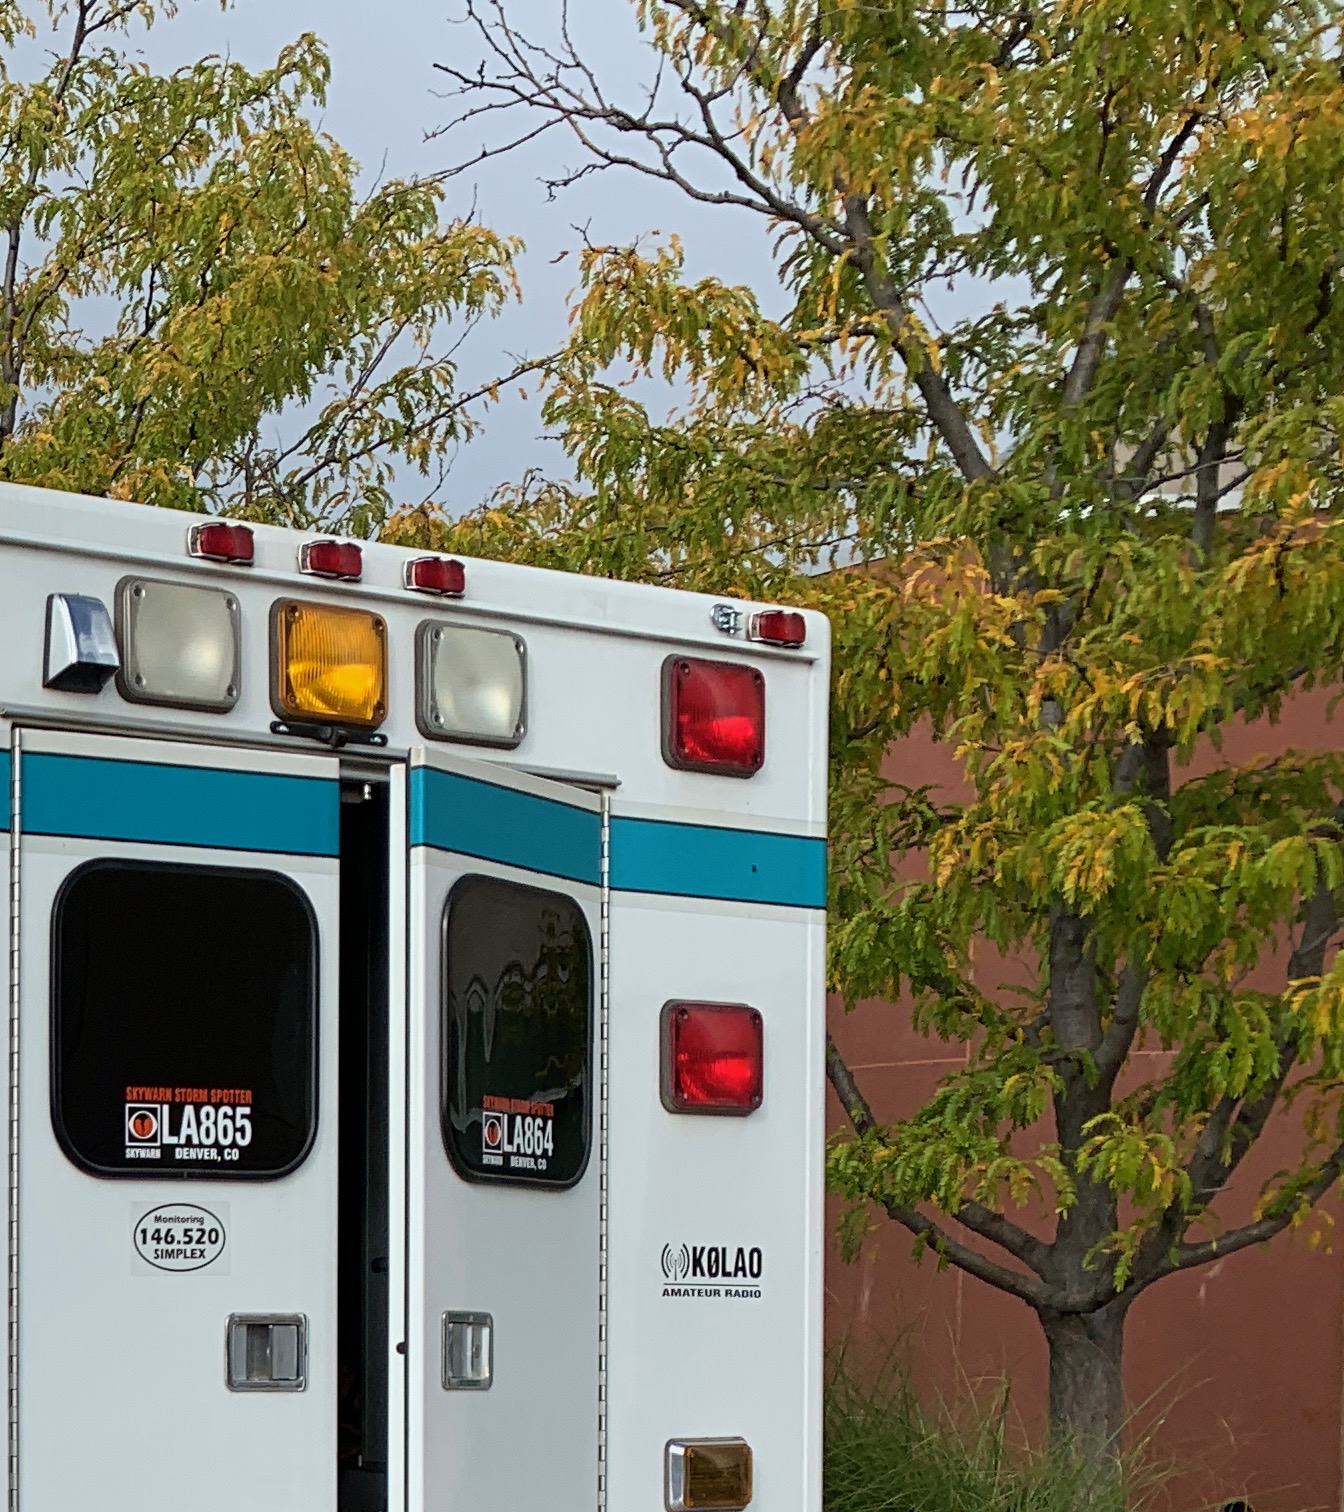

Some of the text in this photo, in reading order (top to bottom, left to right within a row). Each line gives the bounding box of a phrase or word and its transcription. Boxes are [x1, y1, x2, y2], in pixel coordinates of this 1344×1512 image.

[125, 1086, 172, 1102] SKYWARN
[210, 1088, 253, 1104] SPOTTER
[162, 1104, 252, 1146] LA865
[503, 1114, 553, 1156] LA864
[174, 1147, 240, 1162] DENVER, CO
[154, 1215, 205, 1226] Monitoring
[140, 1228, 220, 1245] 146.520
[153, 1248, 206, 1260] SIMPLEX
[662, 1288, 762, 1299] AMATEUR RADIO
